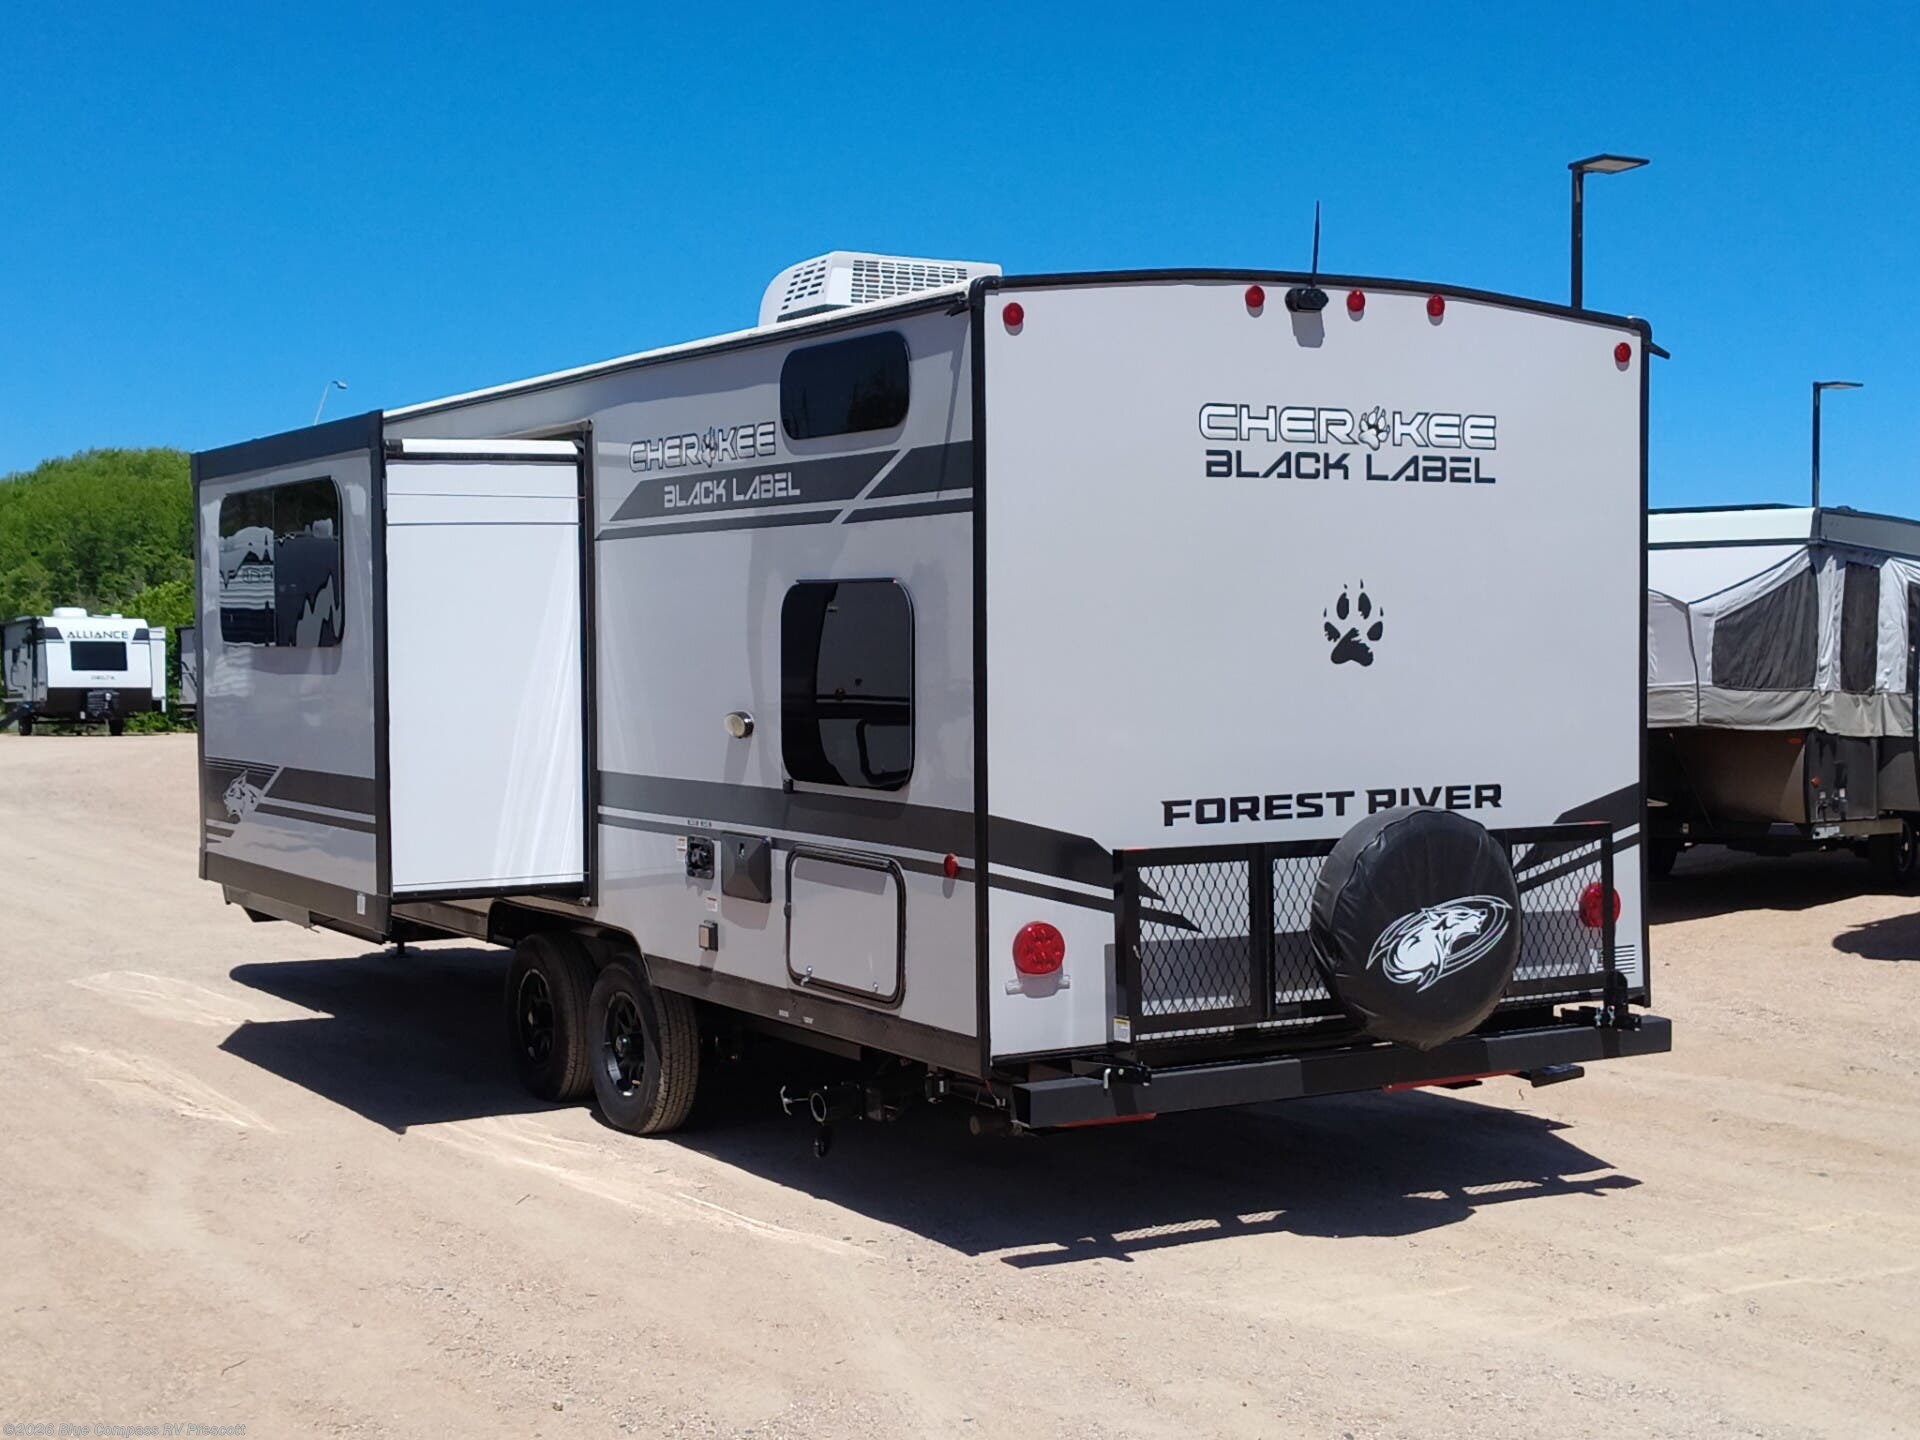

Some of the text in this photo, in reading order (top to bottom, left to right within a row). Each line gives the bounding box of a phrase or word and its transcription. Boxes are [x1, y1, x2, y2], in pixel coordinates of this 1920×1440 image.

[1205, 449, 1496, 484] BLACK LABEL
[664, 471, 801, 509] BLACK LABEL
[67, 630, 128, 640] ALLIANCE
[1160, 790, 1355, 827] FOREST
